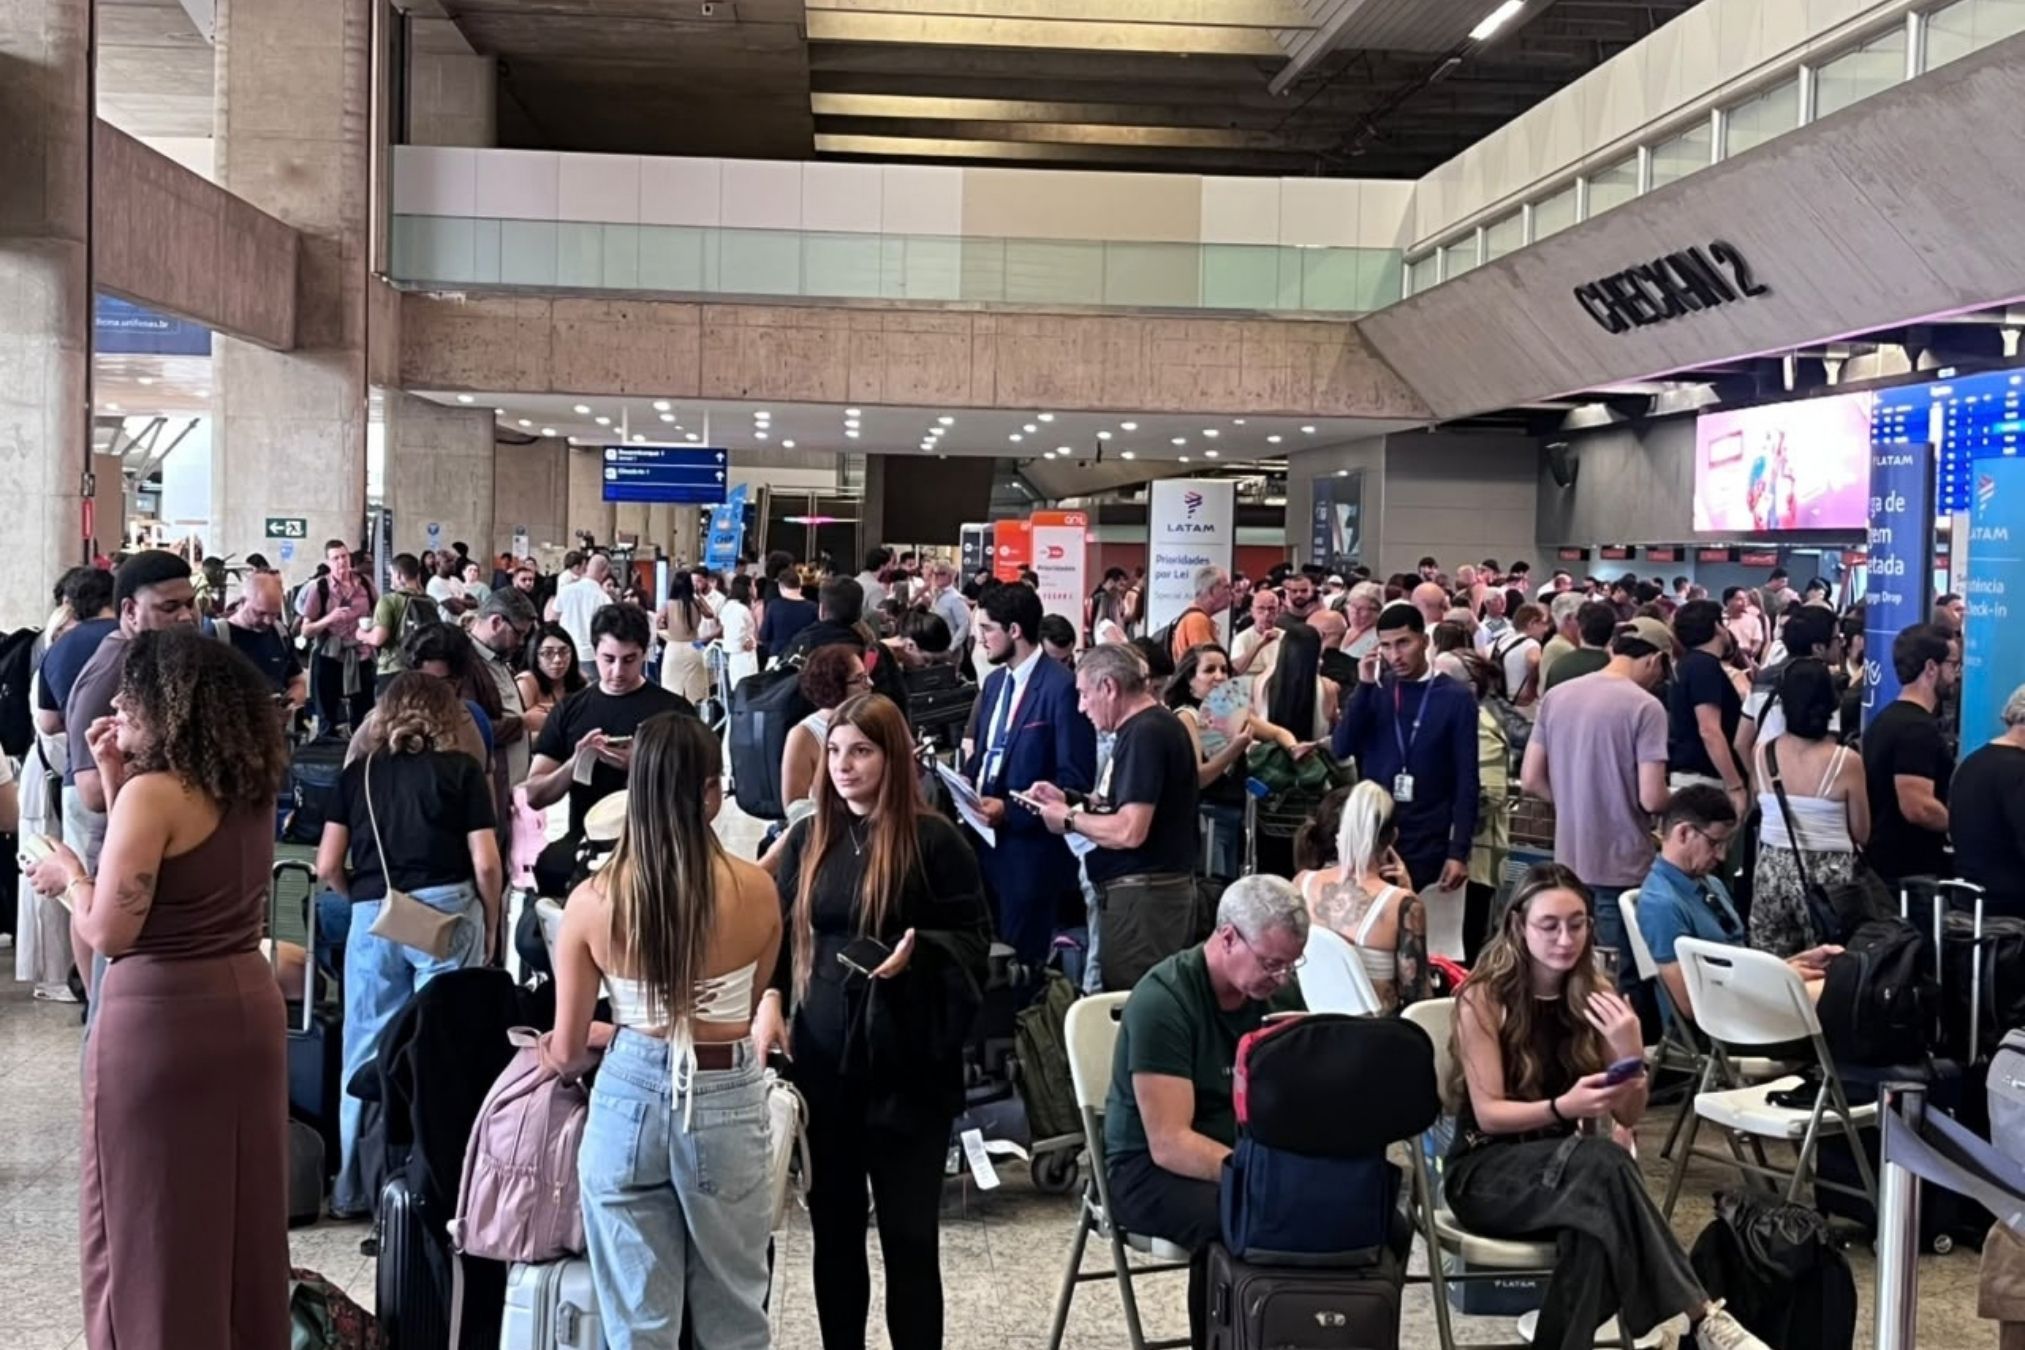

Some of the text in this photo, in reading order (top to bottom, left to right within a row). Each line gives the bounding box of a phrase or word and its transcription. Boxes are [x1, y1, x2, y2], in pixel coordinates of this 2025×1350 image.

[1708, 239, 1769, 298] 2
[1885, 490, 1905, 513] de
[1167, 524, 1215, 533] LATAM
[1155, 553, 1210, 566] Prioridades
[1155, 570, 1189, 581] por Lei
